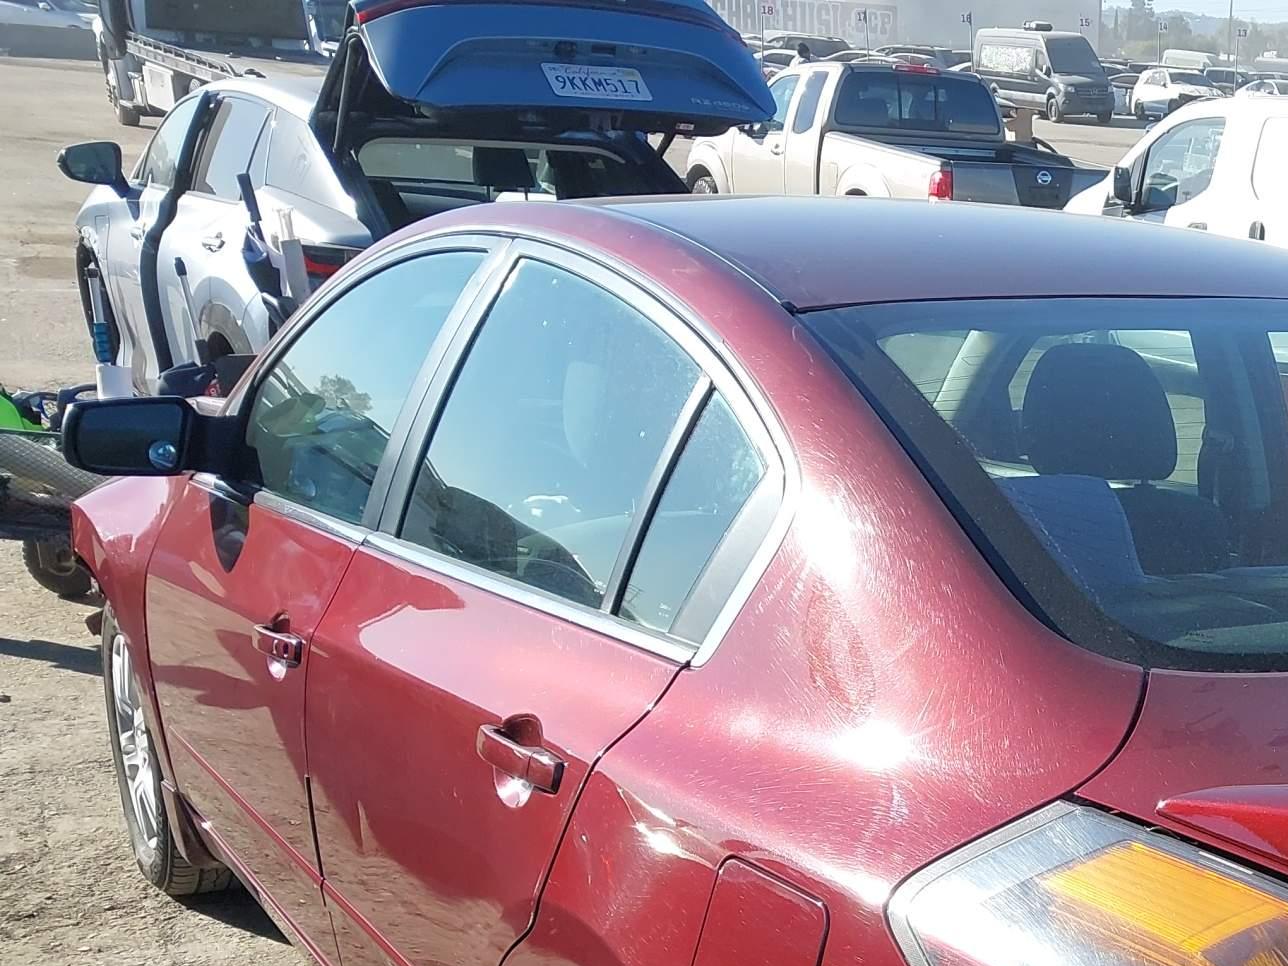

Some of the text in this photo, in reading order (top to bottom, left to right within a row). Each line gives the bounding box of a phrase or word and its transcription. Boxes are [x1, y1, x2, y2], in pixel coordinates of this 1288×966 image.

[761, 6, 774, 15] 18
[1080, 18, 1090, 27] 15
[1159, 23, 1168, 31] 14
[1237, 29, 1247, 38] 13
[554, 74, 641, 95] 9KKM517
